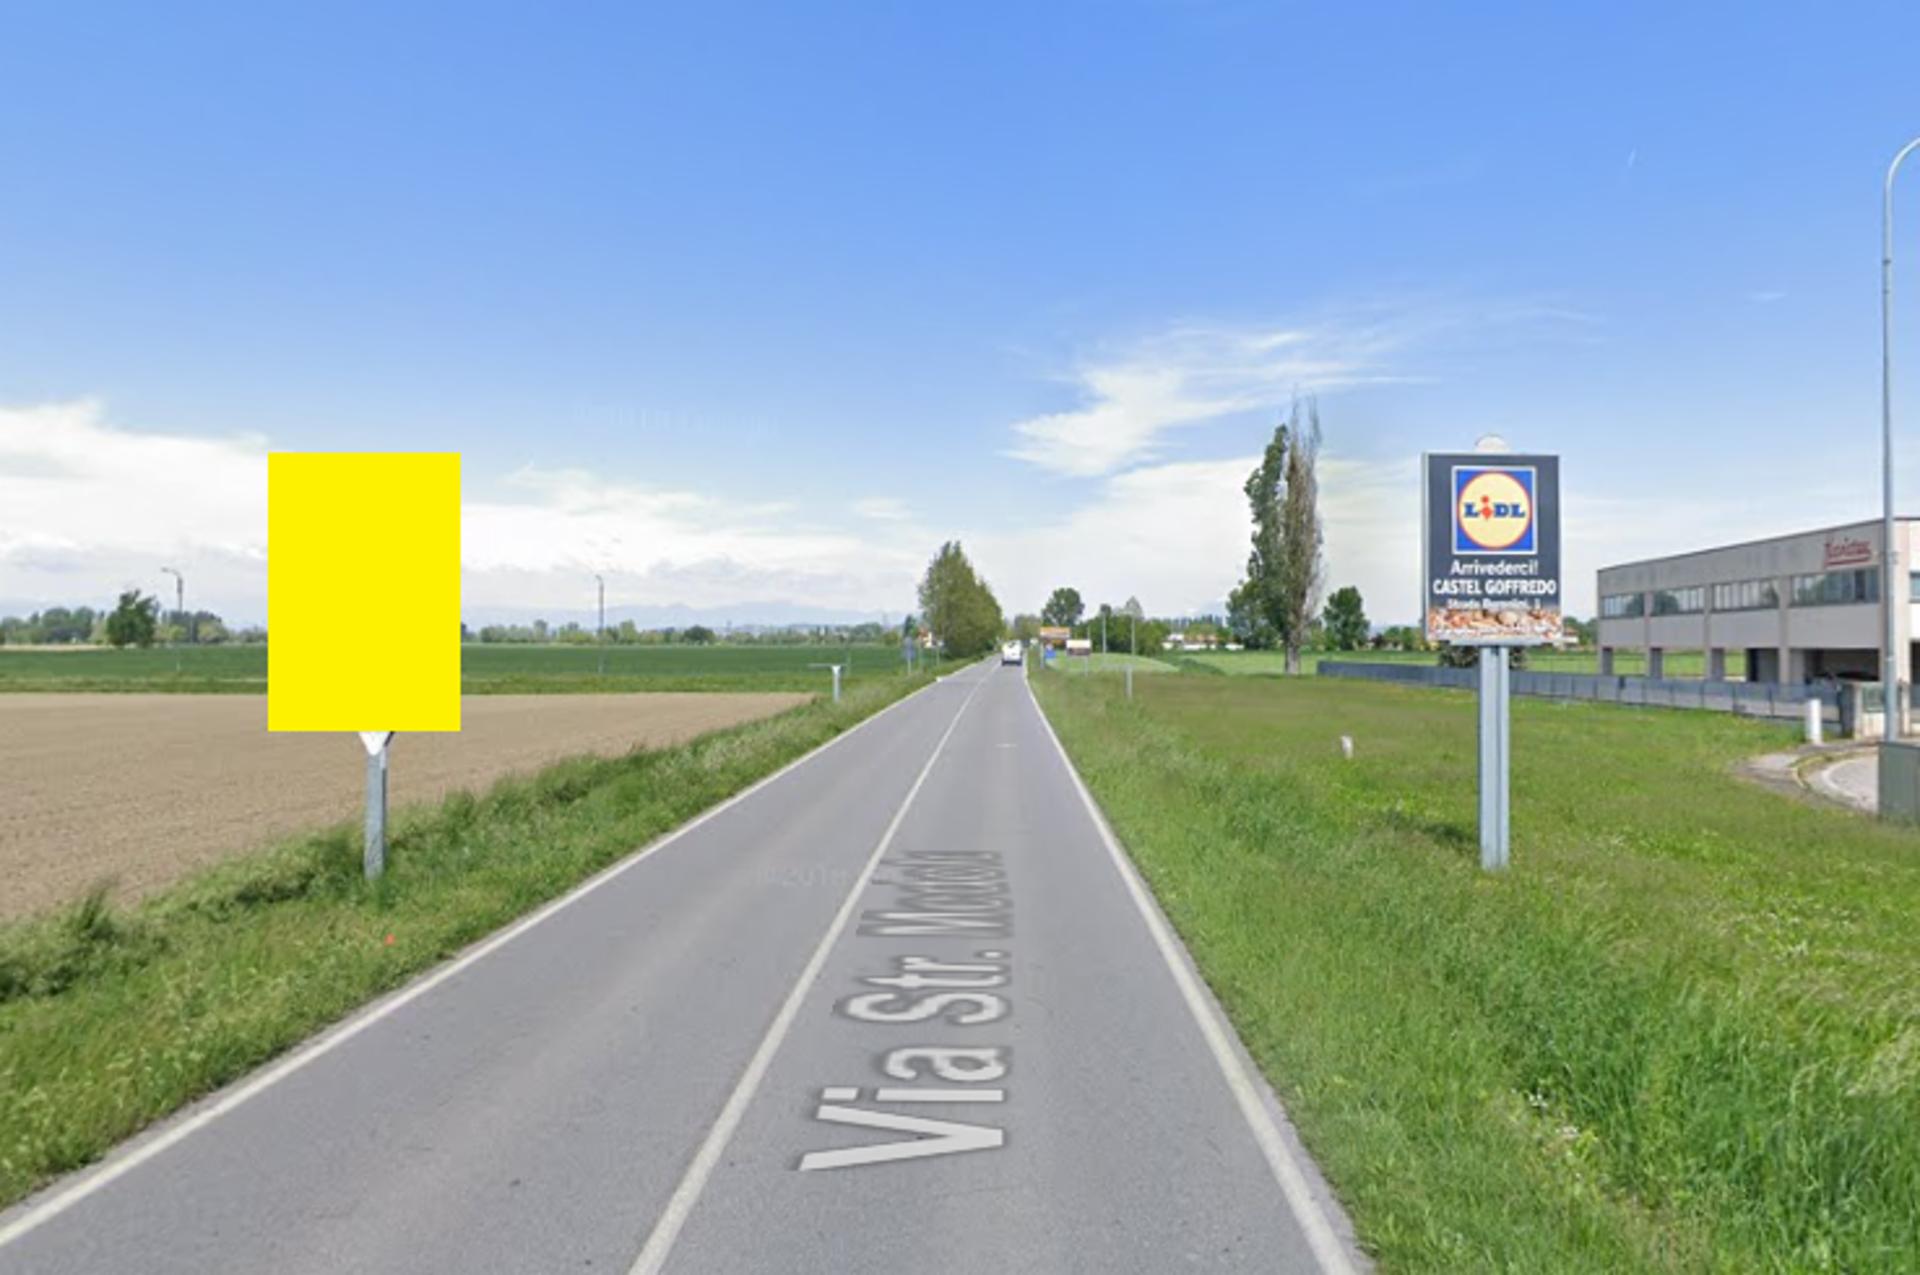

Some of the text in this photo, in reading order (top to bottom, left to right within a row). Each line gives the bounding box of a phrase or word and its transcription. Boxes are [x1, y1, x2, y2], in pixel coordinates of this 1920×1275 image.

[1450, 560, 1539, 577] Arrivederci!
[1432, 579, 1557, 595] CASTEL GOFFREDO
